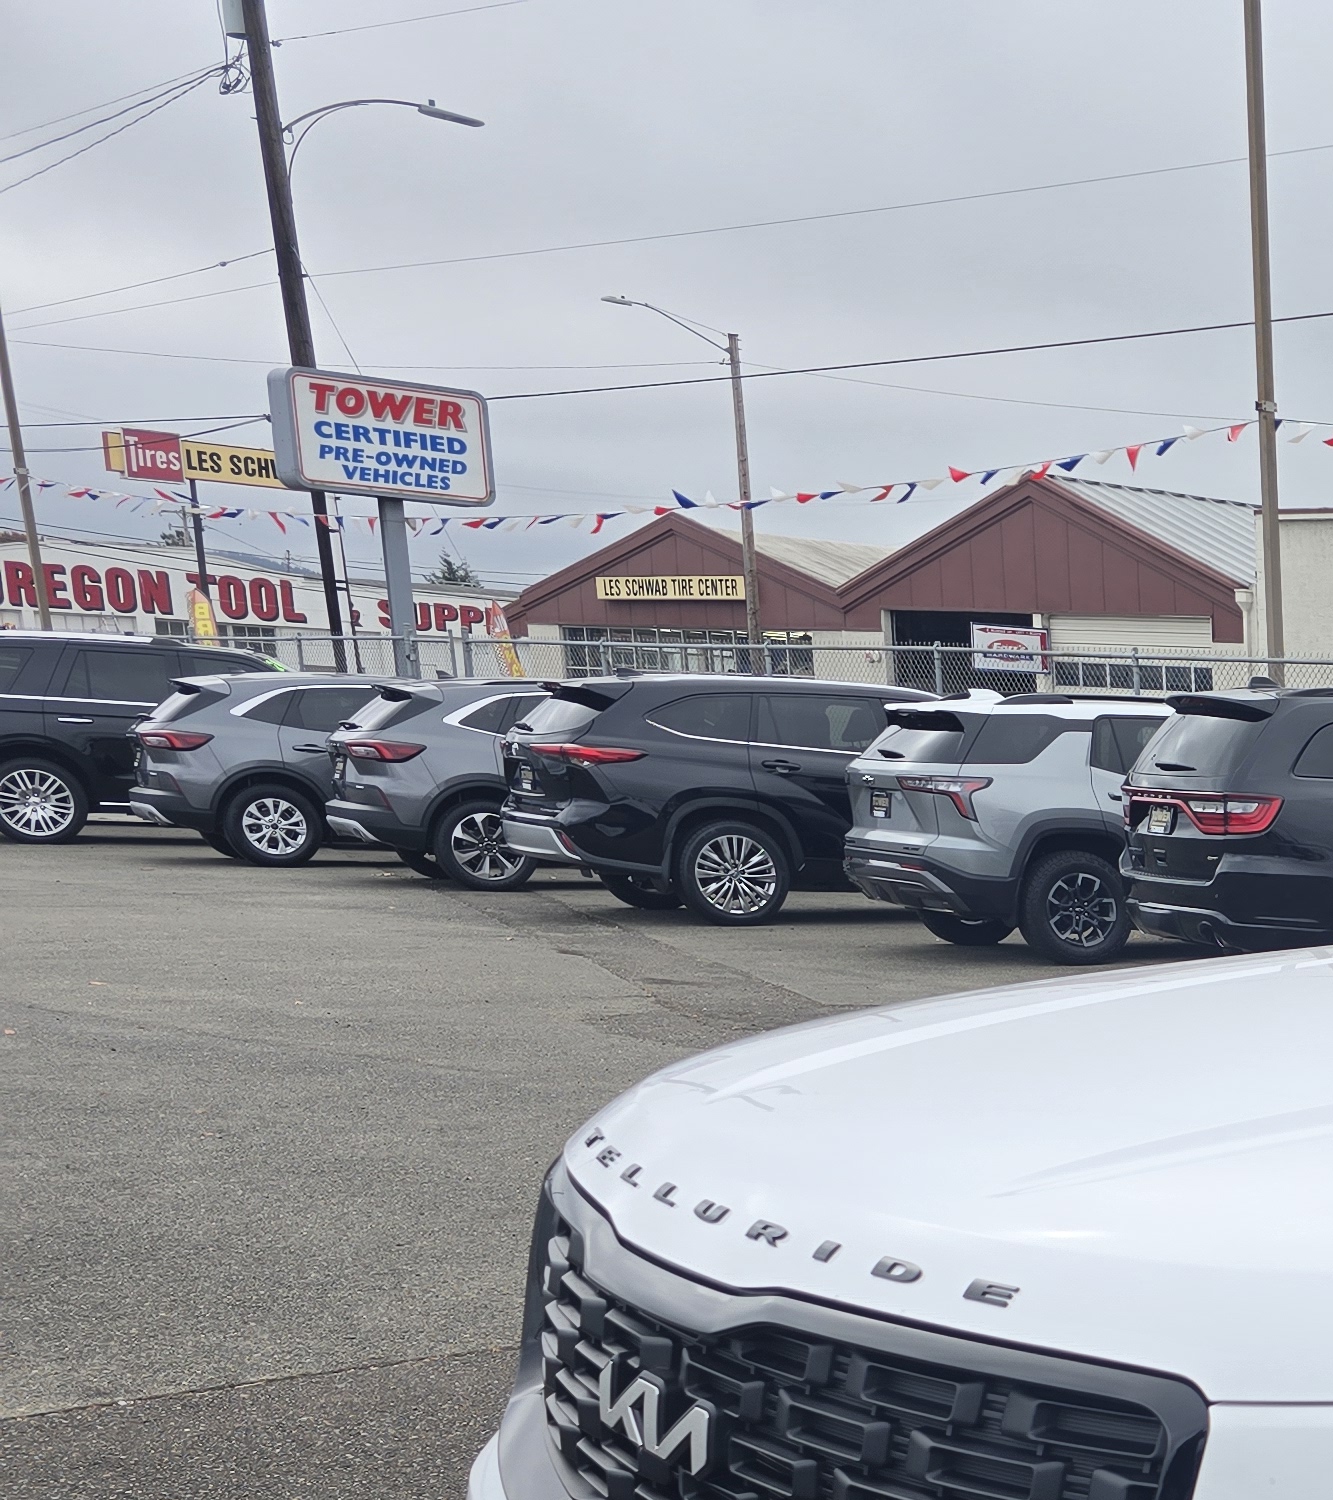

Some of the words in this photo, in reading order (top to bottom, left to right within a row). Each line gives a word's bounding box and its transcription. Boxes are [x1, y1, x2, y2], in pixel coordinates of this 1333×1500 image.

[309, 382, 466, 431] TOWER
[125, 435, 181, 472] Tires
[314, 420, 467, 455] CERTIFIED
[185, 449, 222, 474] LES
[319, 444, 467, 475] PRE-OWNED
[342, 464, 450, 490] VEHICLES
[0, 560, 173, 616] REGON
[603, 579, 621, 596] LES
[625, 579, 668, 597] SCHWAB
[671, 579, 694, 596] TIRE
[698, 579, 738, 596] CENTER
[584, 1127, 1021, 1308] TELLURIDE
[599, 1359, 710, 1476] KIA
